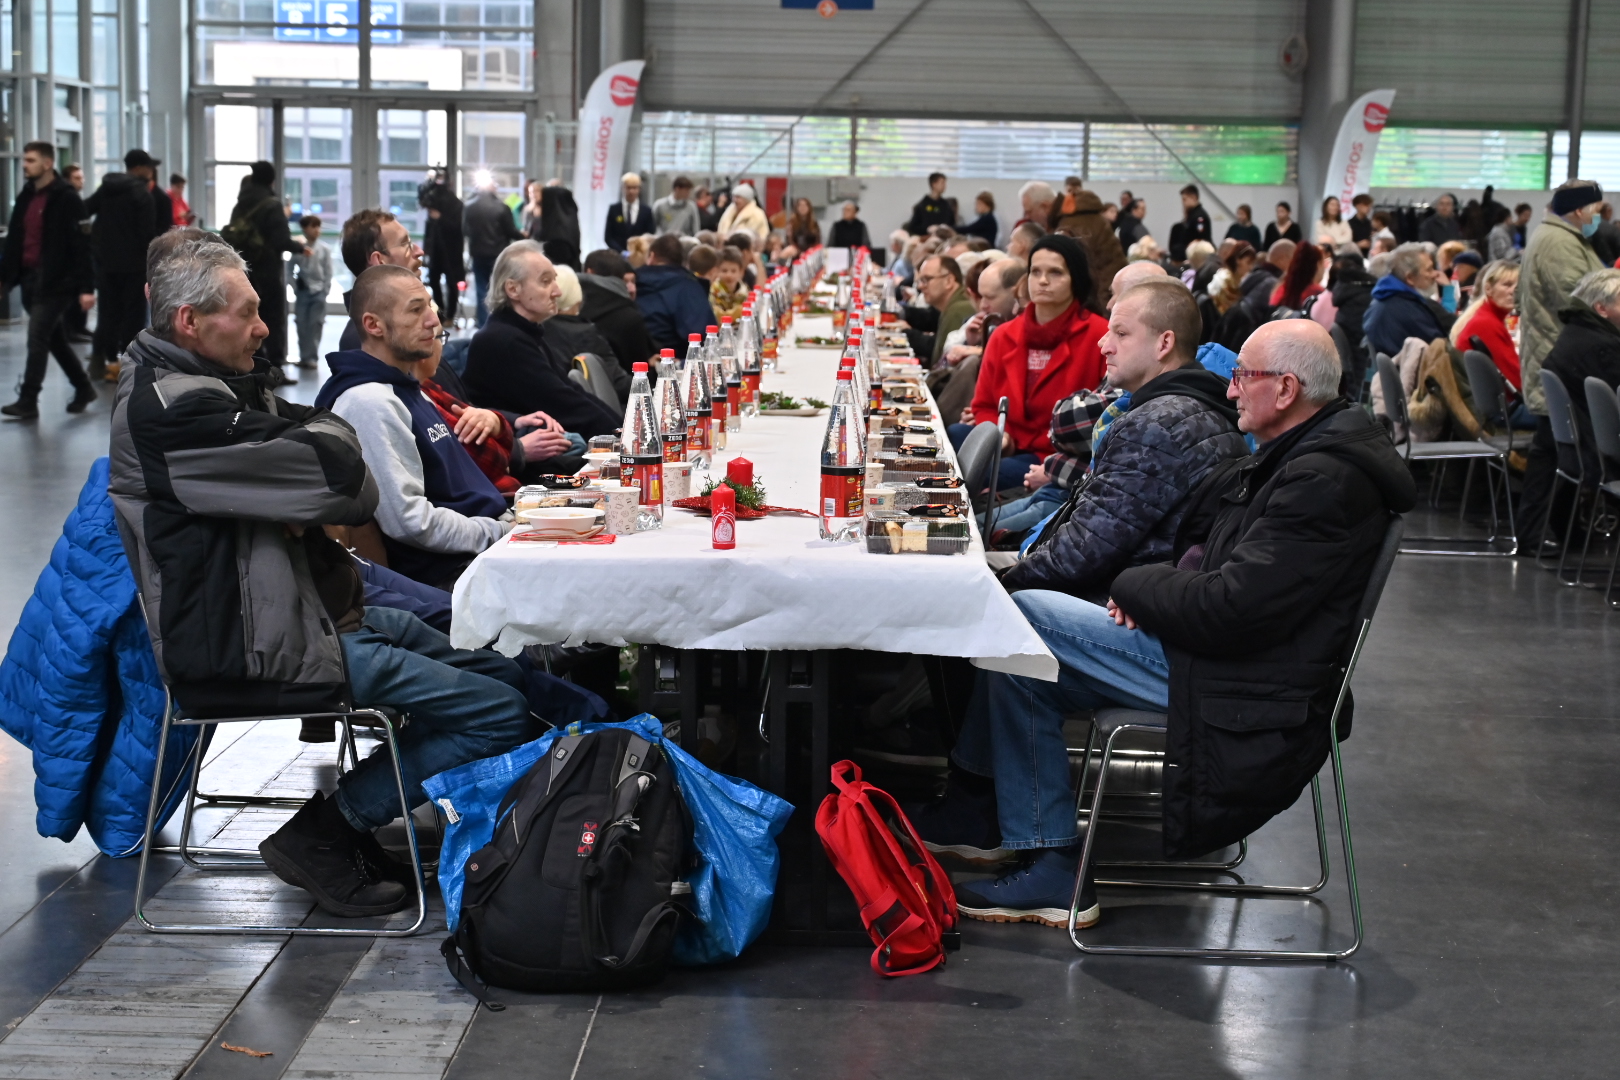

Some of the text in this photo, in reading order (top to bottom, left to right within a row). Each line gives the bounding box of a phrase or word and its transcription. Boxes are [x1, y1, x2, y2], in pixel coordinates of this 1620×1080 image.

[326, 3, 349, 37] 5
[591, 116, 613, 191] SELGROS
[1340, 142, 1363, 214] SELGROS
